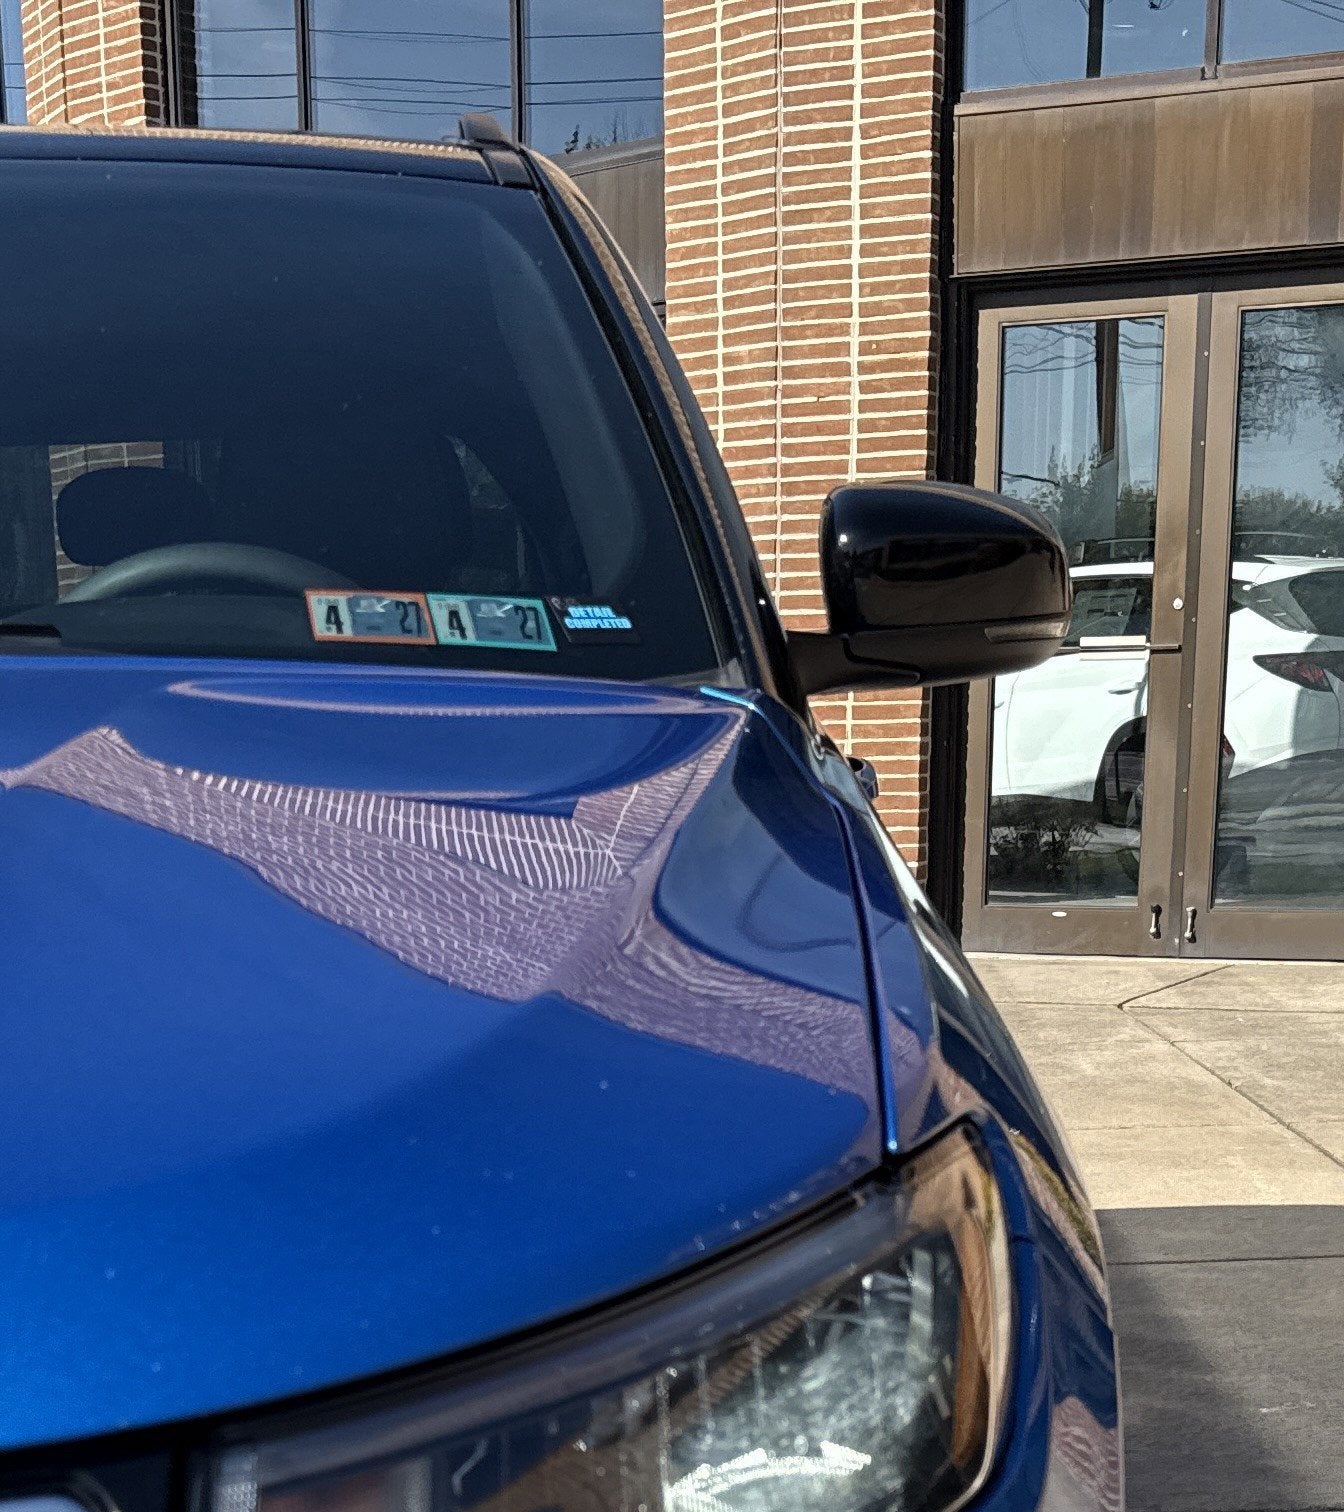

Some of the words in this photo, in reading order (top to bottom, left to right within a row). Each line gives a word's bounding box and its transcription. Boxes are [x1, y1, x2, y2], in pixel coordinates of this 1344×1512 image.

[325, 604, 344, 635] 4
[567, 606, 617, 618] DETAIL
[448, 609, 467, 641] 4
[564, 618, 633, 629] COMPLETED
